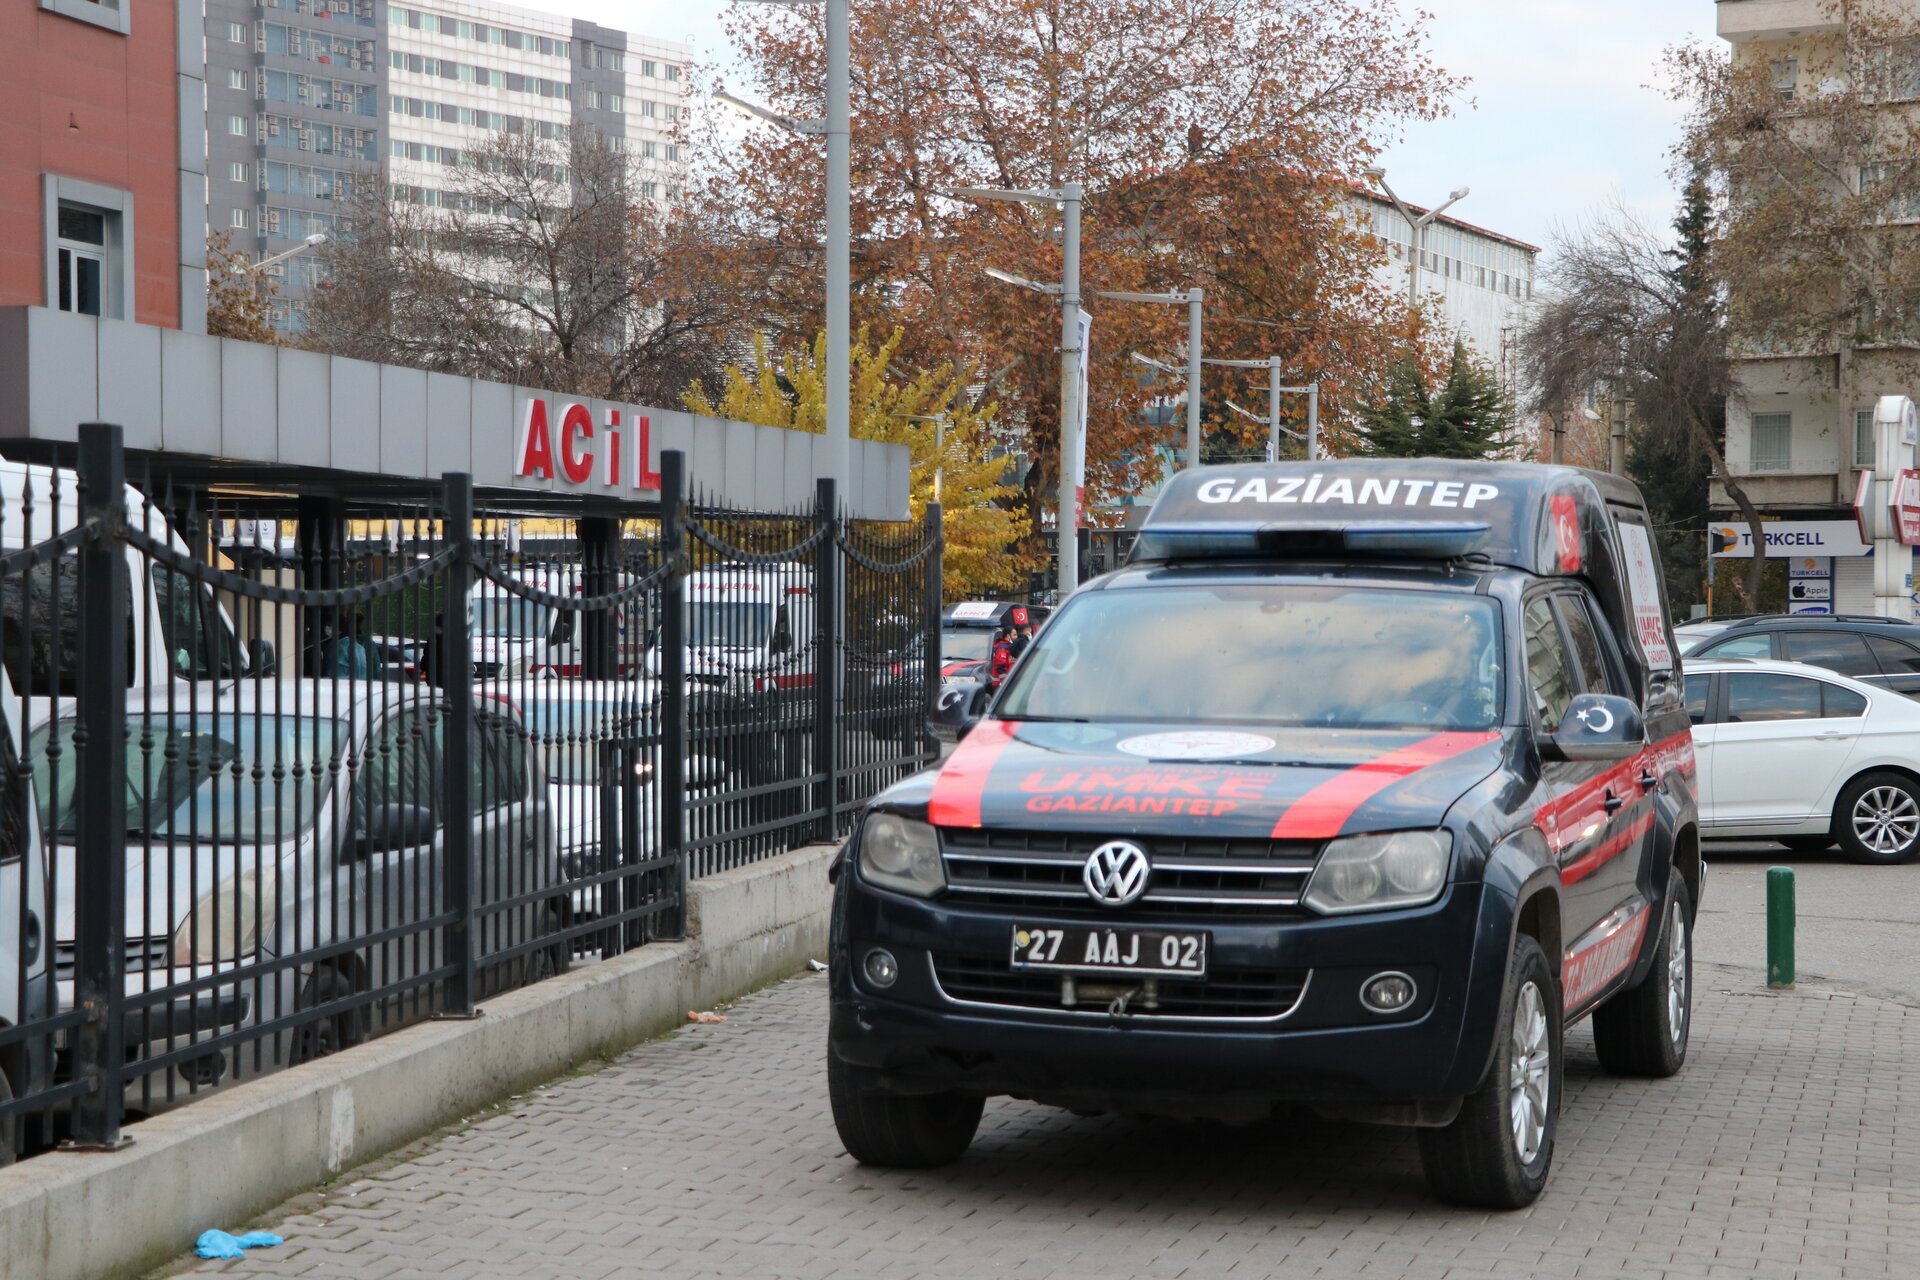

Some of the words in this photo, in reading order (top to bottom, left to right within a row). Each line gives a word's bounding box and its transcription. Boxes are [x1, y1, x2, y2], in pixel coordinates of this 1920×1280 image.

[1197, 474, 1499, 508] GAZİANTEP
[1742, 532, 1824, 546] TRKCELL
[1806, 587, 1829, 595] Apple
[1636, 616, 1665, 646] UMKE
[1026, 794, 1238, 816] GAZİANTEP
[1028, 929, 1064, 961] 27
[1084, 932, 1140, 965] AAJ
[1160, 936, 1199, 967] 02
